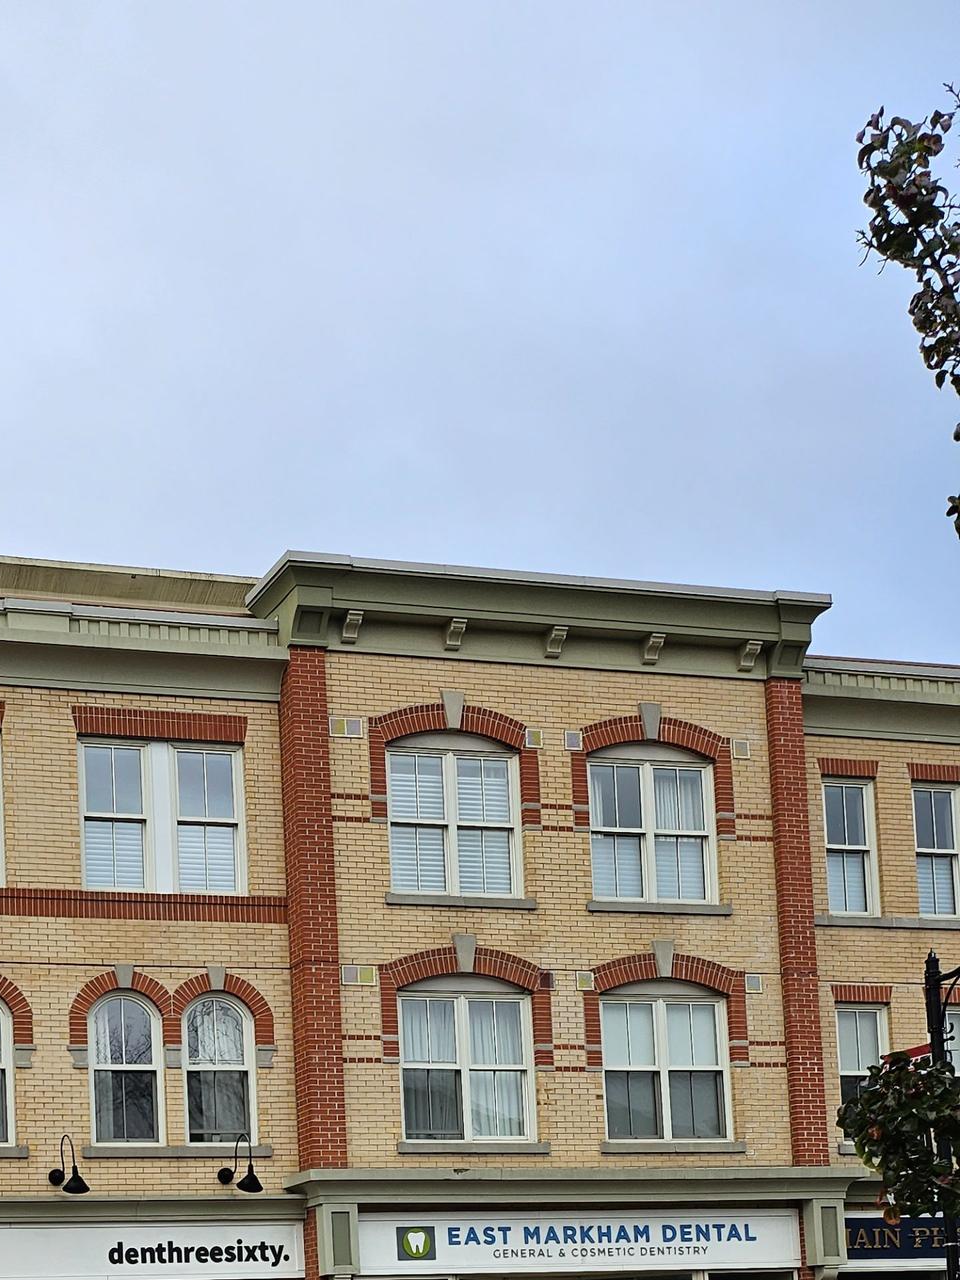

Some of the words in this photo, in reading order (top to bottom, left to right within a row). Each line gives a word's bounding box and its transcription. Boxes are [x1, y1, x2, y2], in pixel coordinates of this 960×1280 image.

[447, 1226, 512, 1246] EAST
[523, 1224, 651, 1246] MARKHAM
[662, 1223, 758, 1243] DENTAL
[108, 1239, 290, 1267] denthreesixty.
[493, 1249, 553, 1259] GENERAL
[558, 1249, 566, 1258] &
[571, 1247, 635, 1258] COSMETIC
[640, 1246, 709, 1256] DENTISTRY
